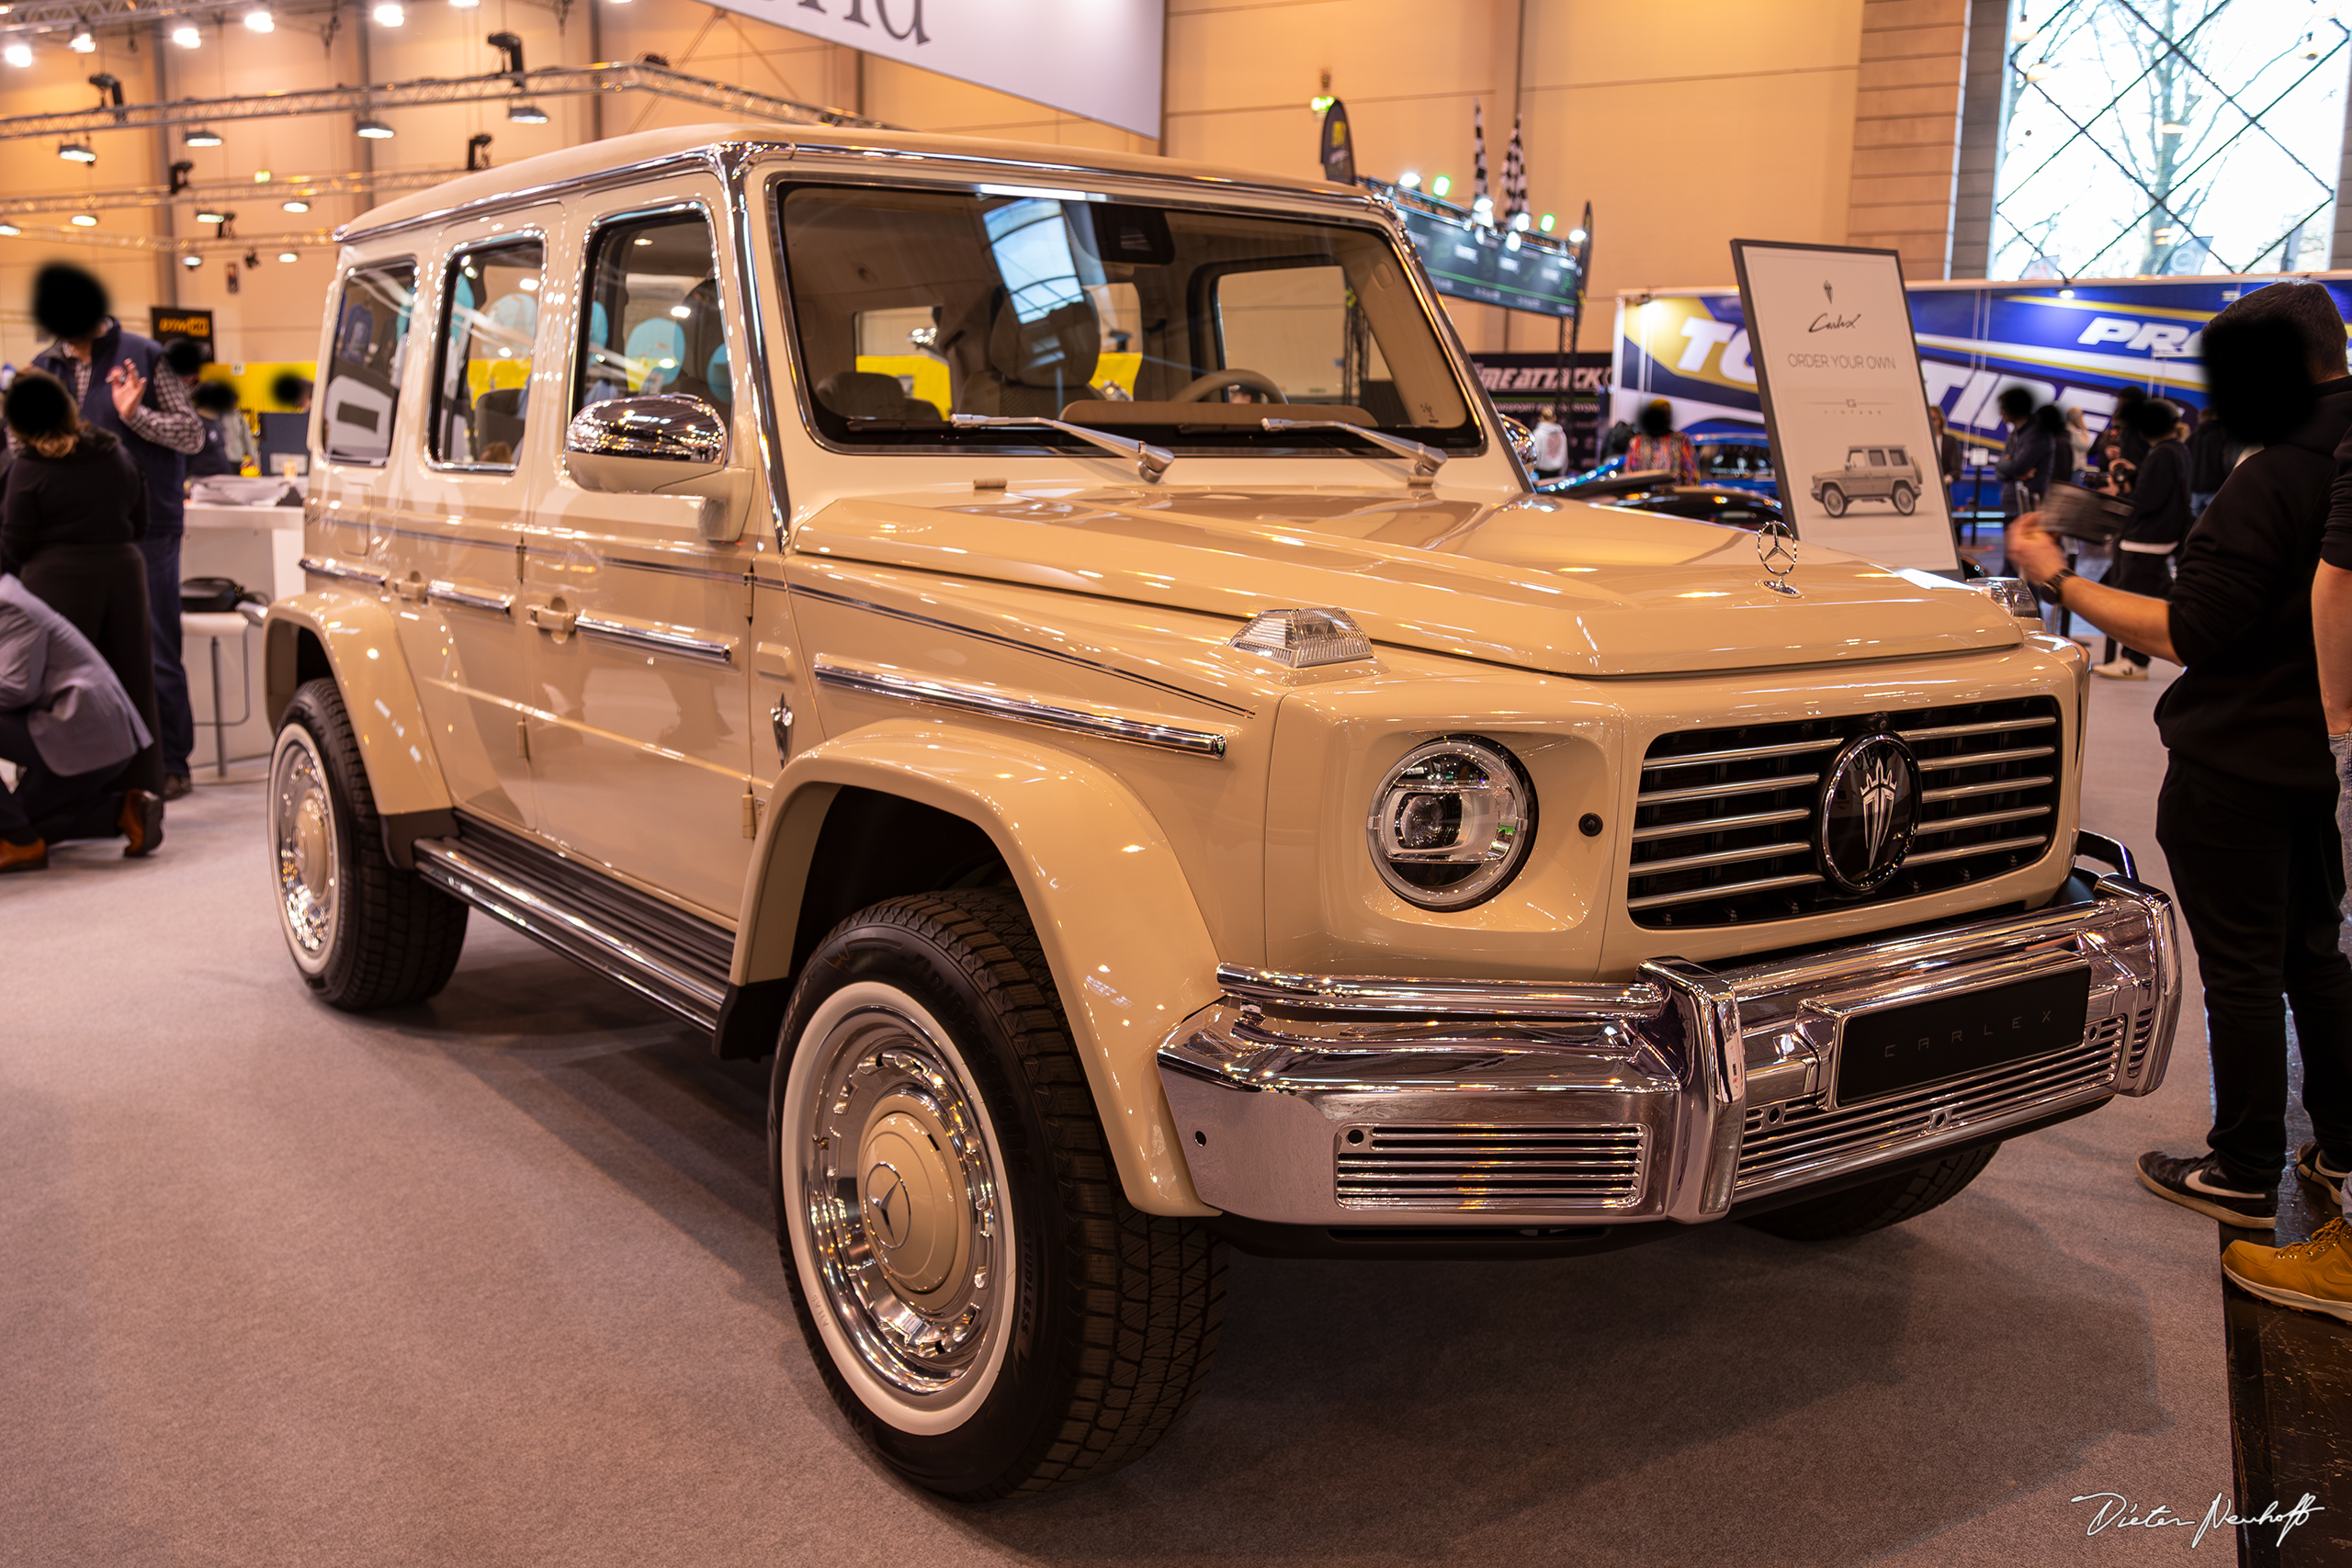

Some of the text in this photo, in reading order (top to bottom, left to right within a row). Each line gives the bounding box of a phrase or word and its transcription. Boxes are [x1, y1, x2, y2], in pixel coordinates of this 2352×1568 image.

[1788, 353, 1897, 369] ORDER YOUR OWN
[1884, 1010, 2051, 1057] CARLEX
[1020, 1225, 1034, 1337] STUDLESS
